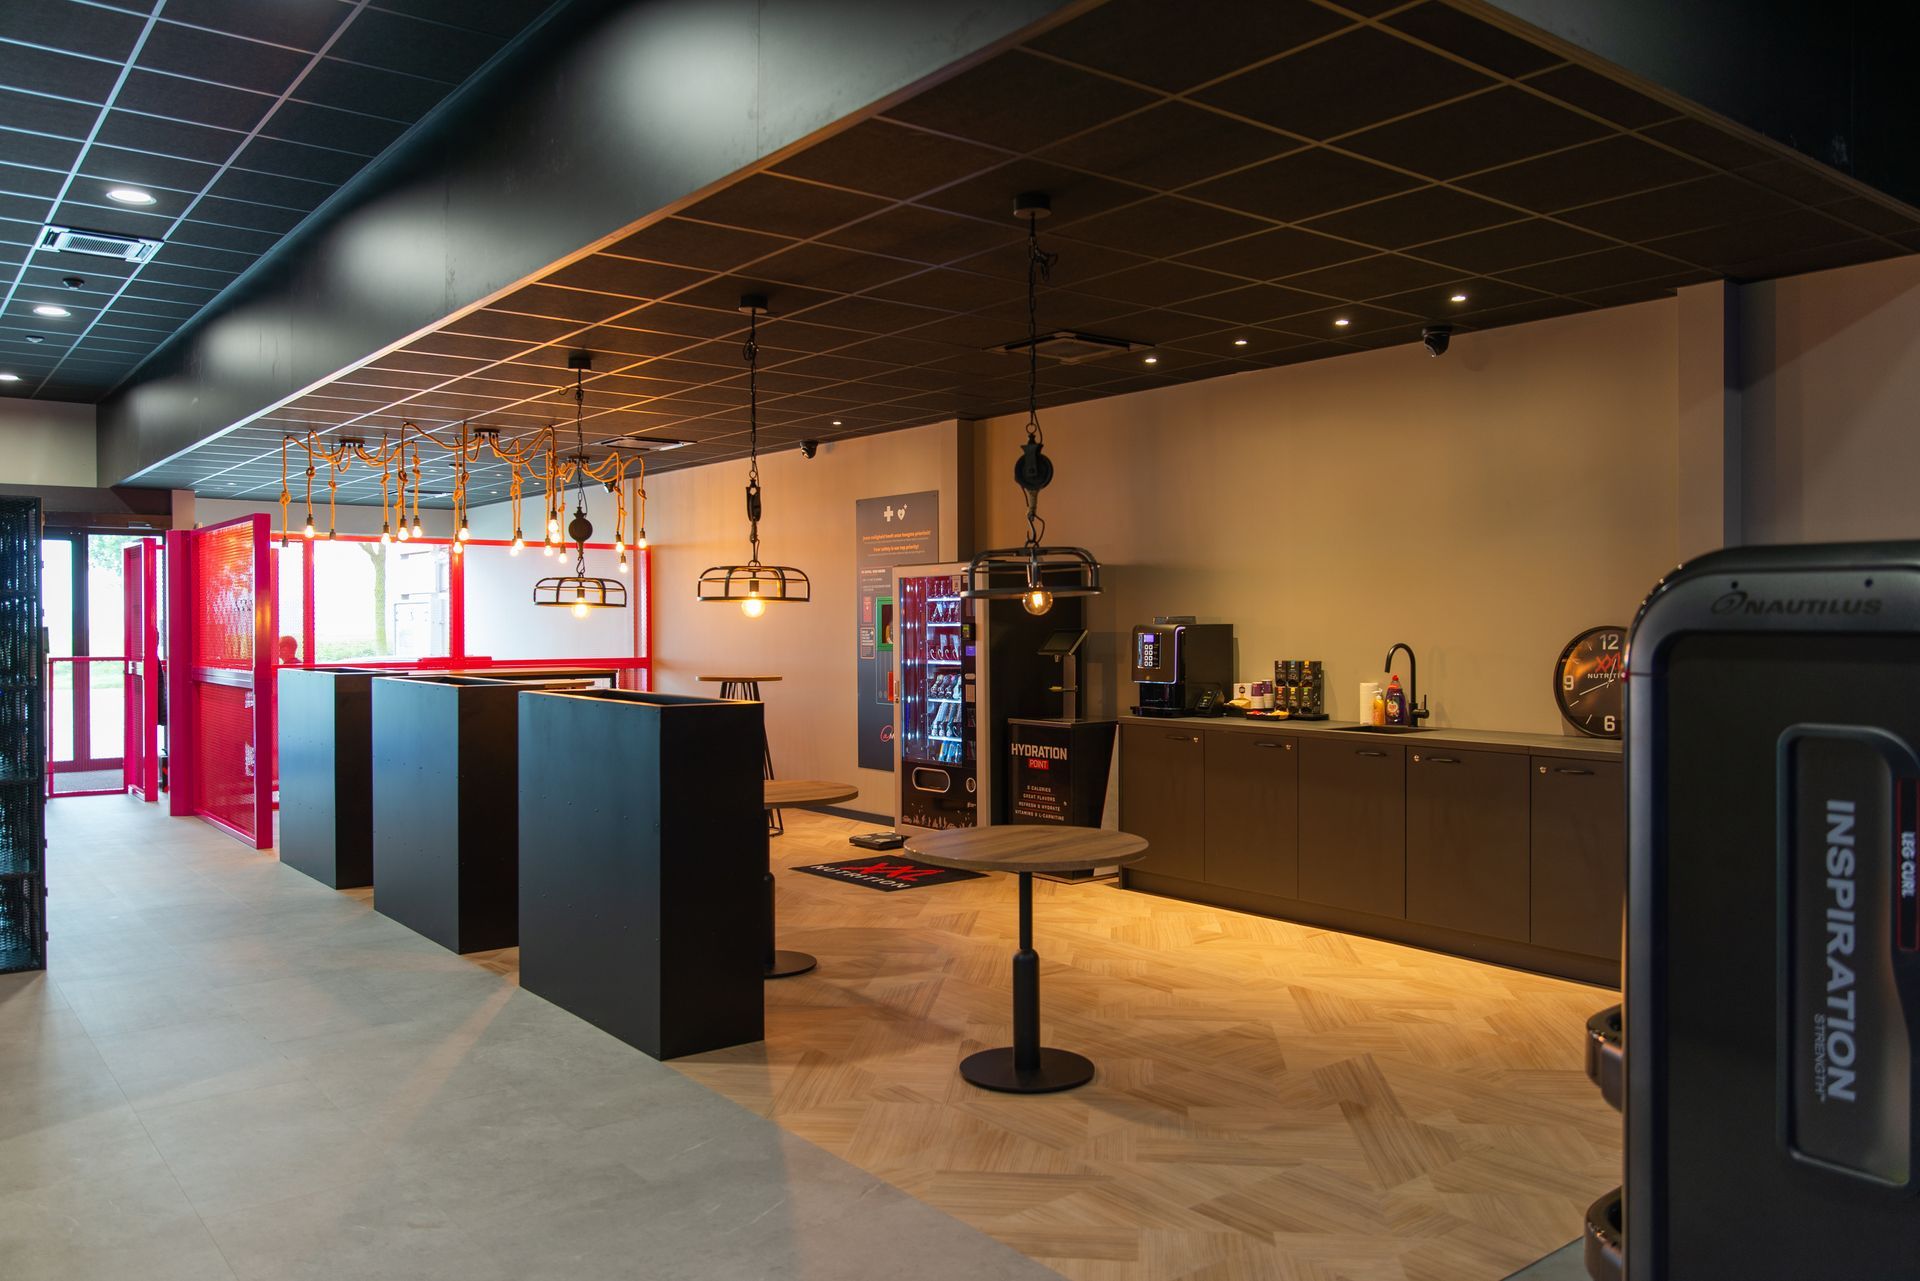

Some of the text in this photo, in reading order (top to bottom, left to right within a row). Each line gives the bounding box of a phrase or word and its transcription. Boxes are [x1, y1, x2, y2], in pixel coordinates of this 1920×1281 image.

[1744, 599, 1883, 615] NAUTILUS
[1600, 634, 1619, 650] 12
[1564, 675, 1575, 691] 9
[1604, 715, 1616, 732] 6
[1011, 743, 1068, 760] HYDRATION
[1029, 759, 1048, 769] POINT
[840, 862, 945, 881] XXL
[1901, 831, 1915, 898] LEG CURL
[810, 865, 911, 889] NUTRITION
[1826, 799, 1856, 1103] INSPIRATION
